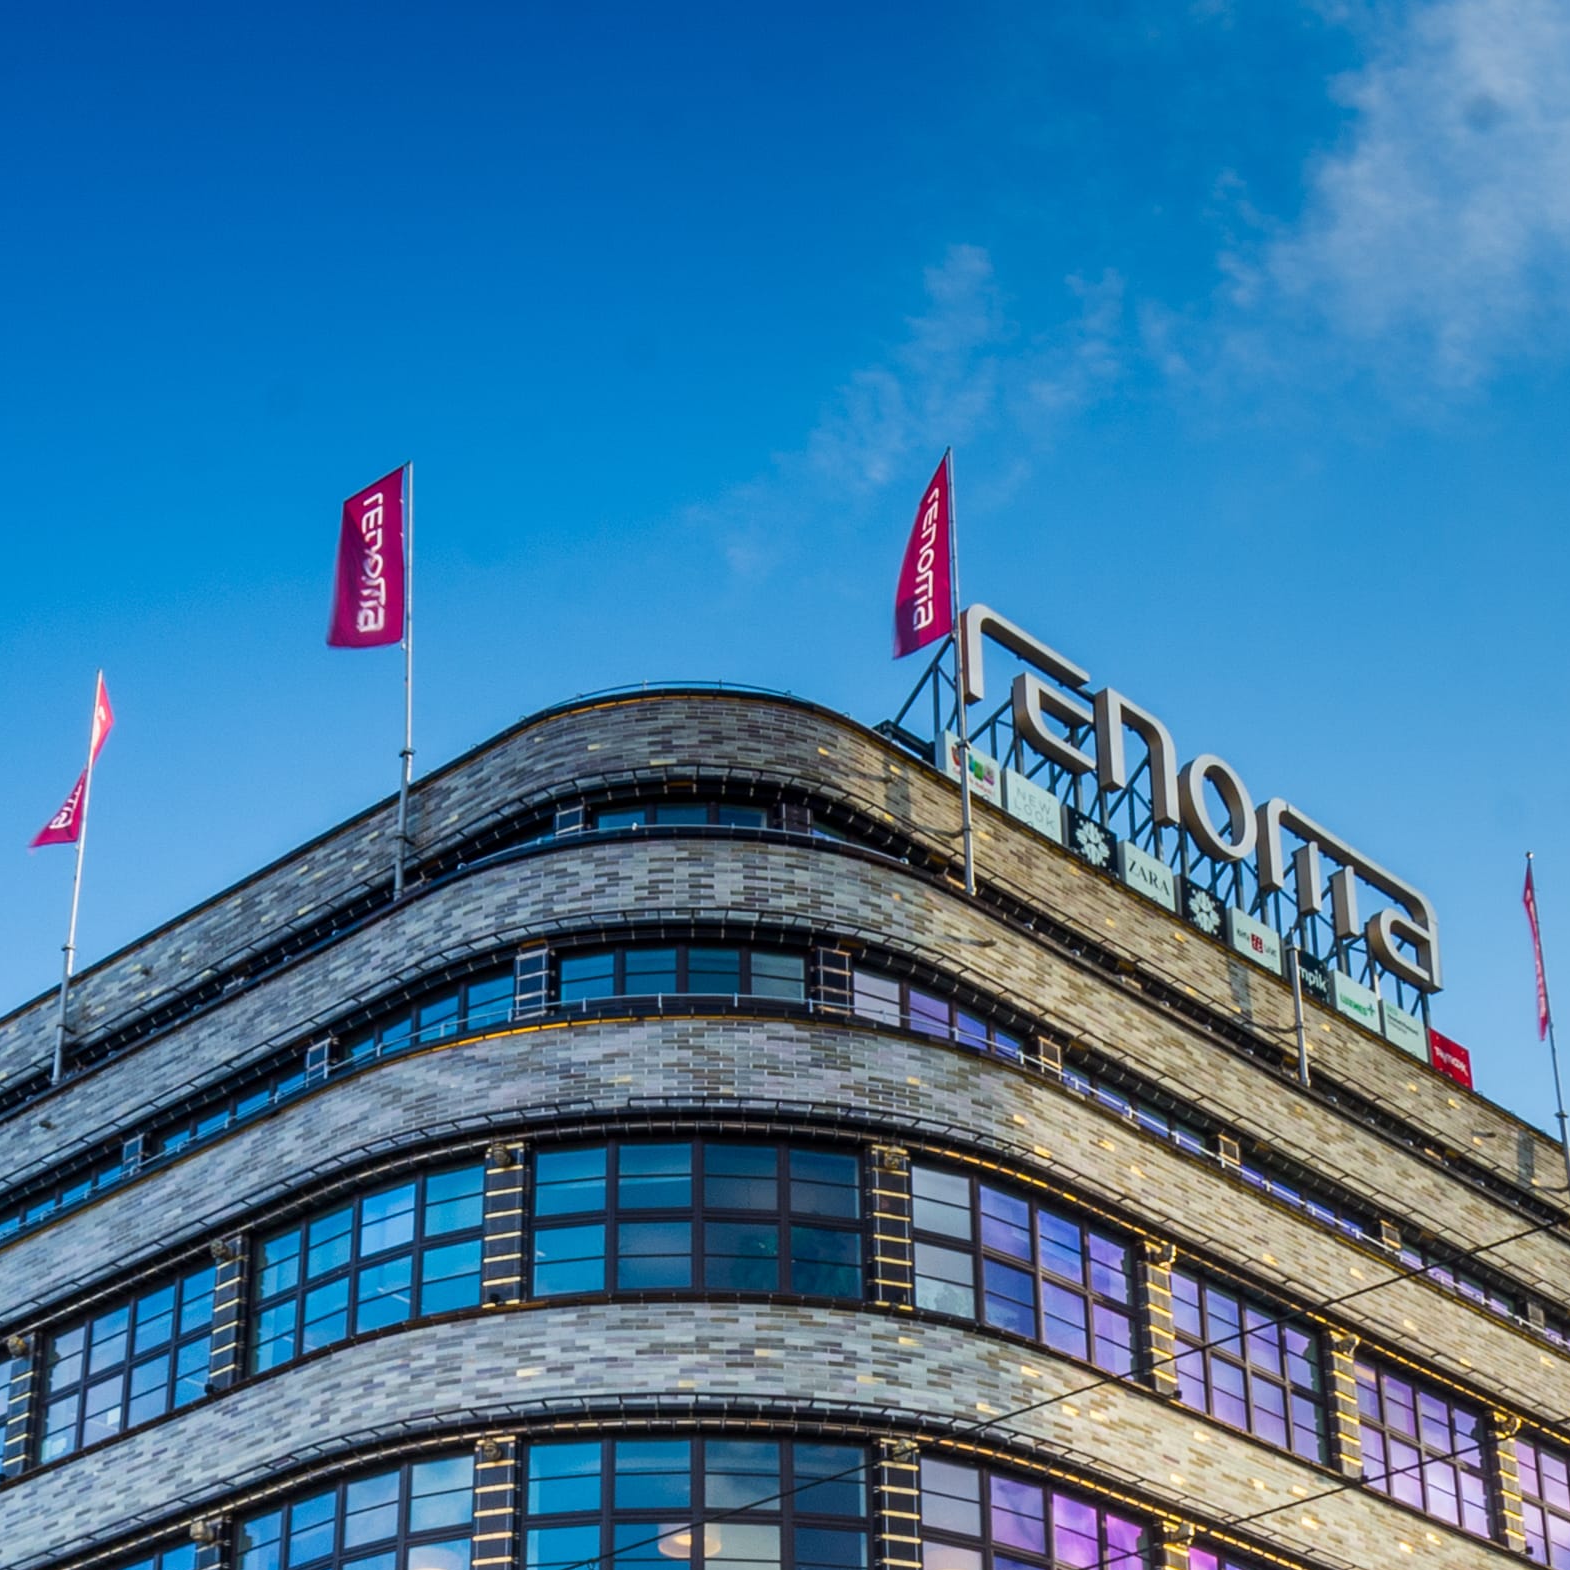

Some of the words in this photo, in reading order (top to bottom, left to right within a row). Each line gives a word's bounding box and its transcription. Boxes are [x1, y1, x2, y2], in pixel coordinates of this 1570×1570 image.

[356, 491, 386, 633] renoma
[912, 487, 940, 631] renoma
[961, 603, 1442, 993] renoma
[1013, 797, 1056, 830] LOOK
[1017, 787, 1051, 815] NEW
[1127, 856, 1171, 897] ZARA
[1297, 963, 1328, 992] mpik
